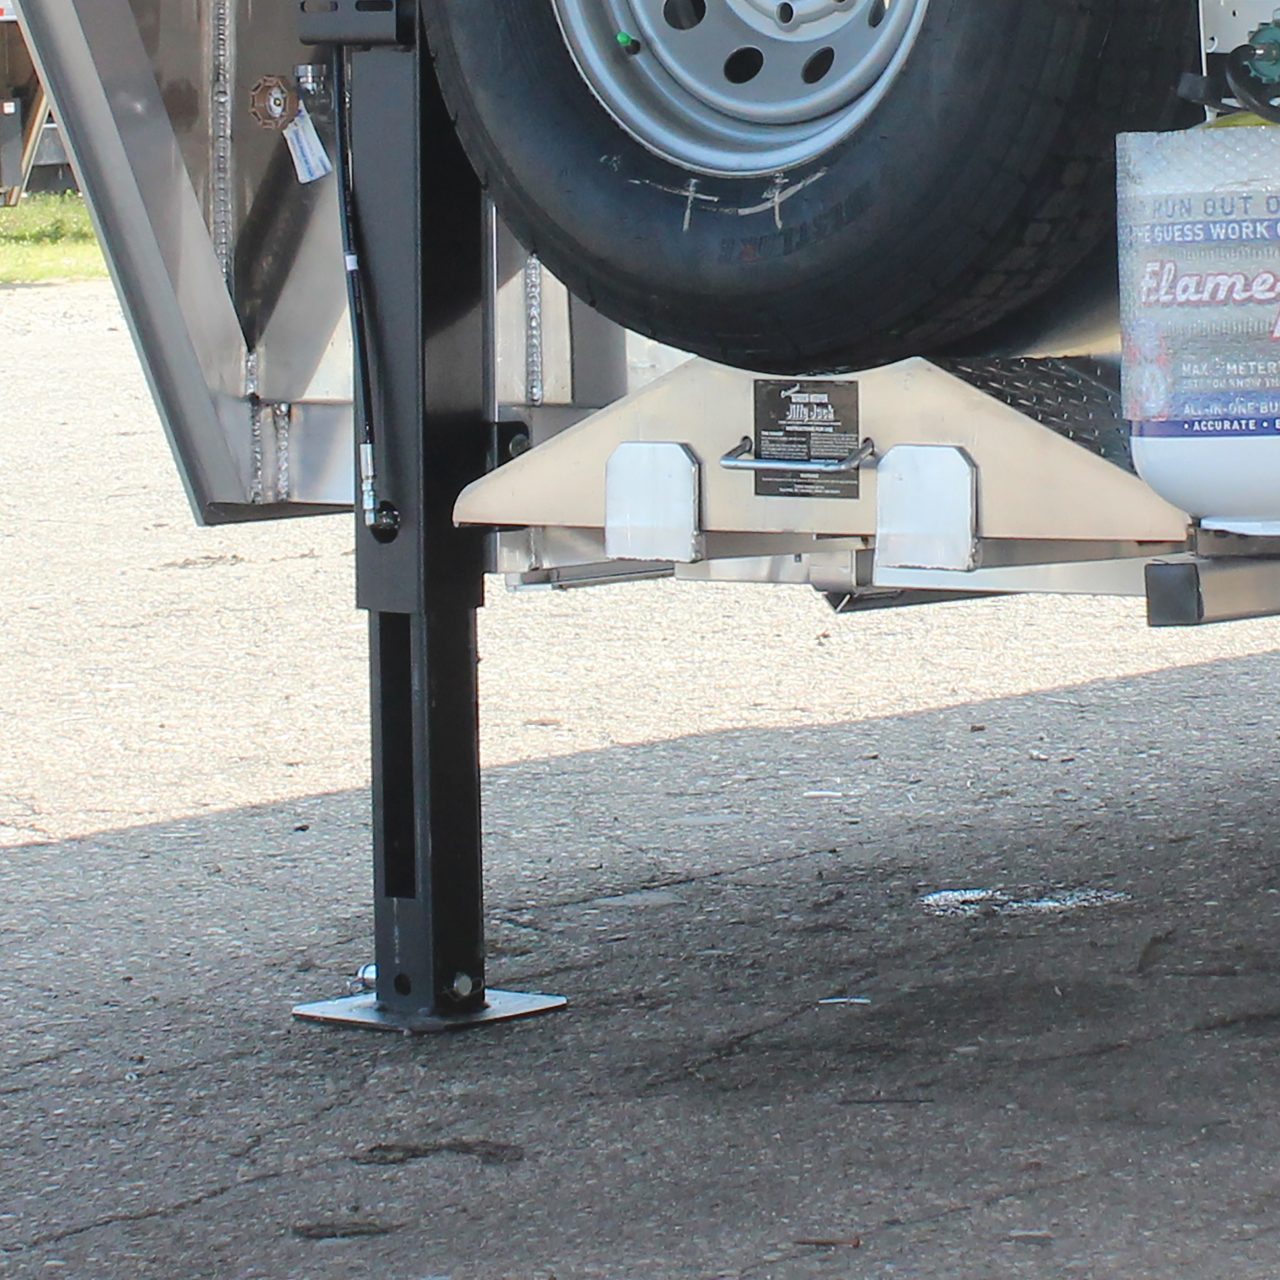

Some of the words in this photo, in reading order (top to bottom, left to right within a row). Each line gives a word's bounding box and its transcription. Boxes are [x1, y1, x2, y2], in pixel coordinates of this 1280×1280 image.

[1152, 197, 1192, 219] RUN
[1203, 195, 1253, 216] OUT
[1154, 224, 1204, 242] GUESS
[1210, 221, 1270, 241] WORK
[1137, 259, 1280, 307] Flame
[1193, 419, 1257, 431] ACCURATE
